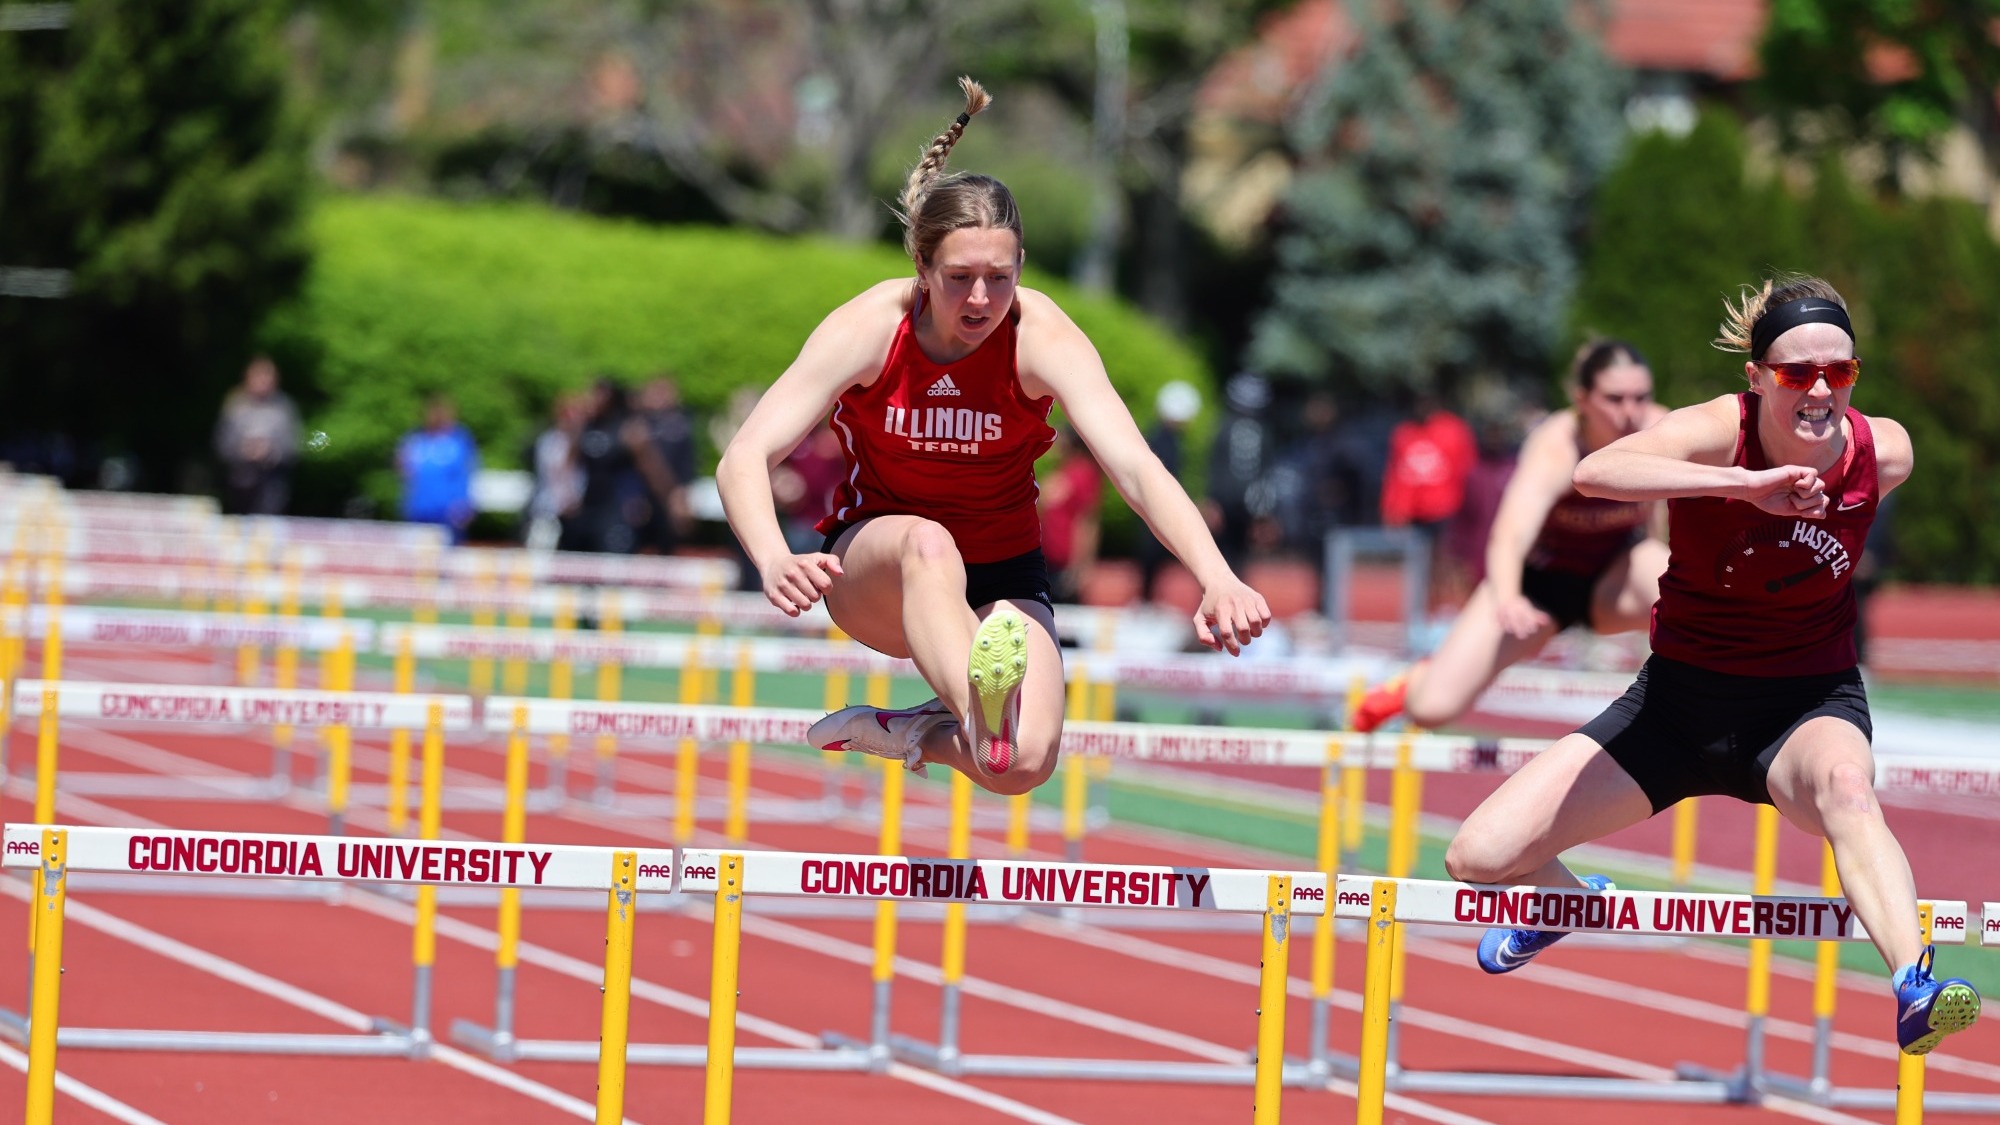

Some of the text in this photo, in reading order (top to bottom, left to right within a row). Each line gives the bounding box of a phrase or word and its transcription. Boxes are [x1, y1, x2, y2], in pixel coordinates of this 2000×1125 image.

[927, 387, 961, 396] adidas
[884, 405, 1002, 442] ILLINOIS
[907, 439, 979, 455] TECH
[1791, 520, 1844, 561] HASTE
[128, 835, 323, 876] CONCORDIA
[337, 843, 553, 885] UNIVERSITY
[801, 860, 989, 899] CONCORDIA
[1002, 866, 1210, 908] UNIVERSITY
[1454, 889, 1640, 930] CONCORDIA
[1652, 898, 1852, 937] UNIVERSITY
